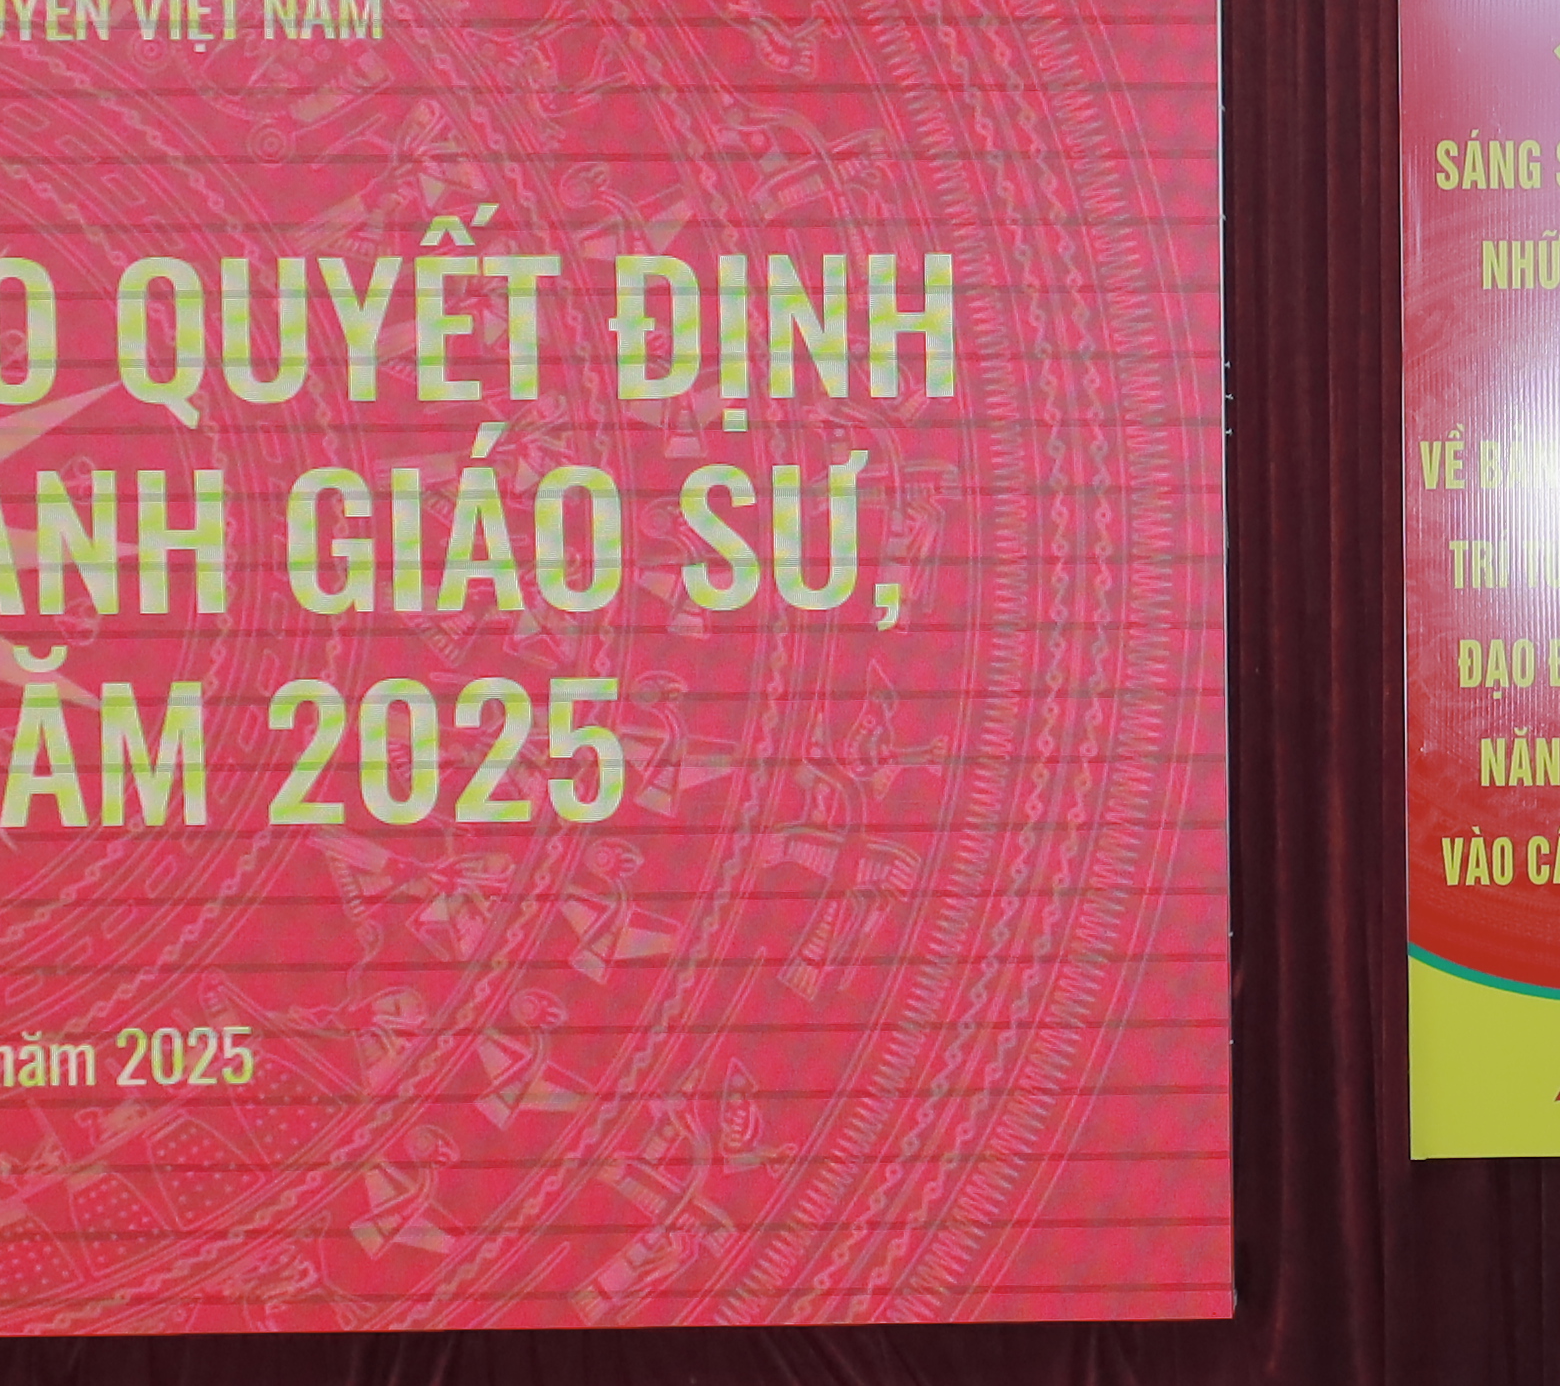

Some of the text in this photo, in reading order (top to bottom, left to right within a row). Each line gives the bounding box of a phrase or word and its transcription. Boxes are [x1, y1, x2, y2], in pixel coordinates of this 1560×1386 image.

[1437, 130, 1541, 189] SÁNG
[117, 204, 561, 428] QUYẾT
[609, 253, 955, 431] ĐỊNH
[1421, 424, 1464, 489] VỀ
[287, 422, 622, 615] GIÁO
[680, 450, 902, 630] SƯ,
[1450, 529, 1508, 590] TRÍ
[1458, 638, 1534, 699] ĐẠO
[269, 677, 625, 824] 2025
[1444, 826, 1513, 885] VÀO
[117, 1026, 254, 1085] 2025
